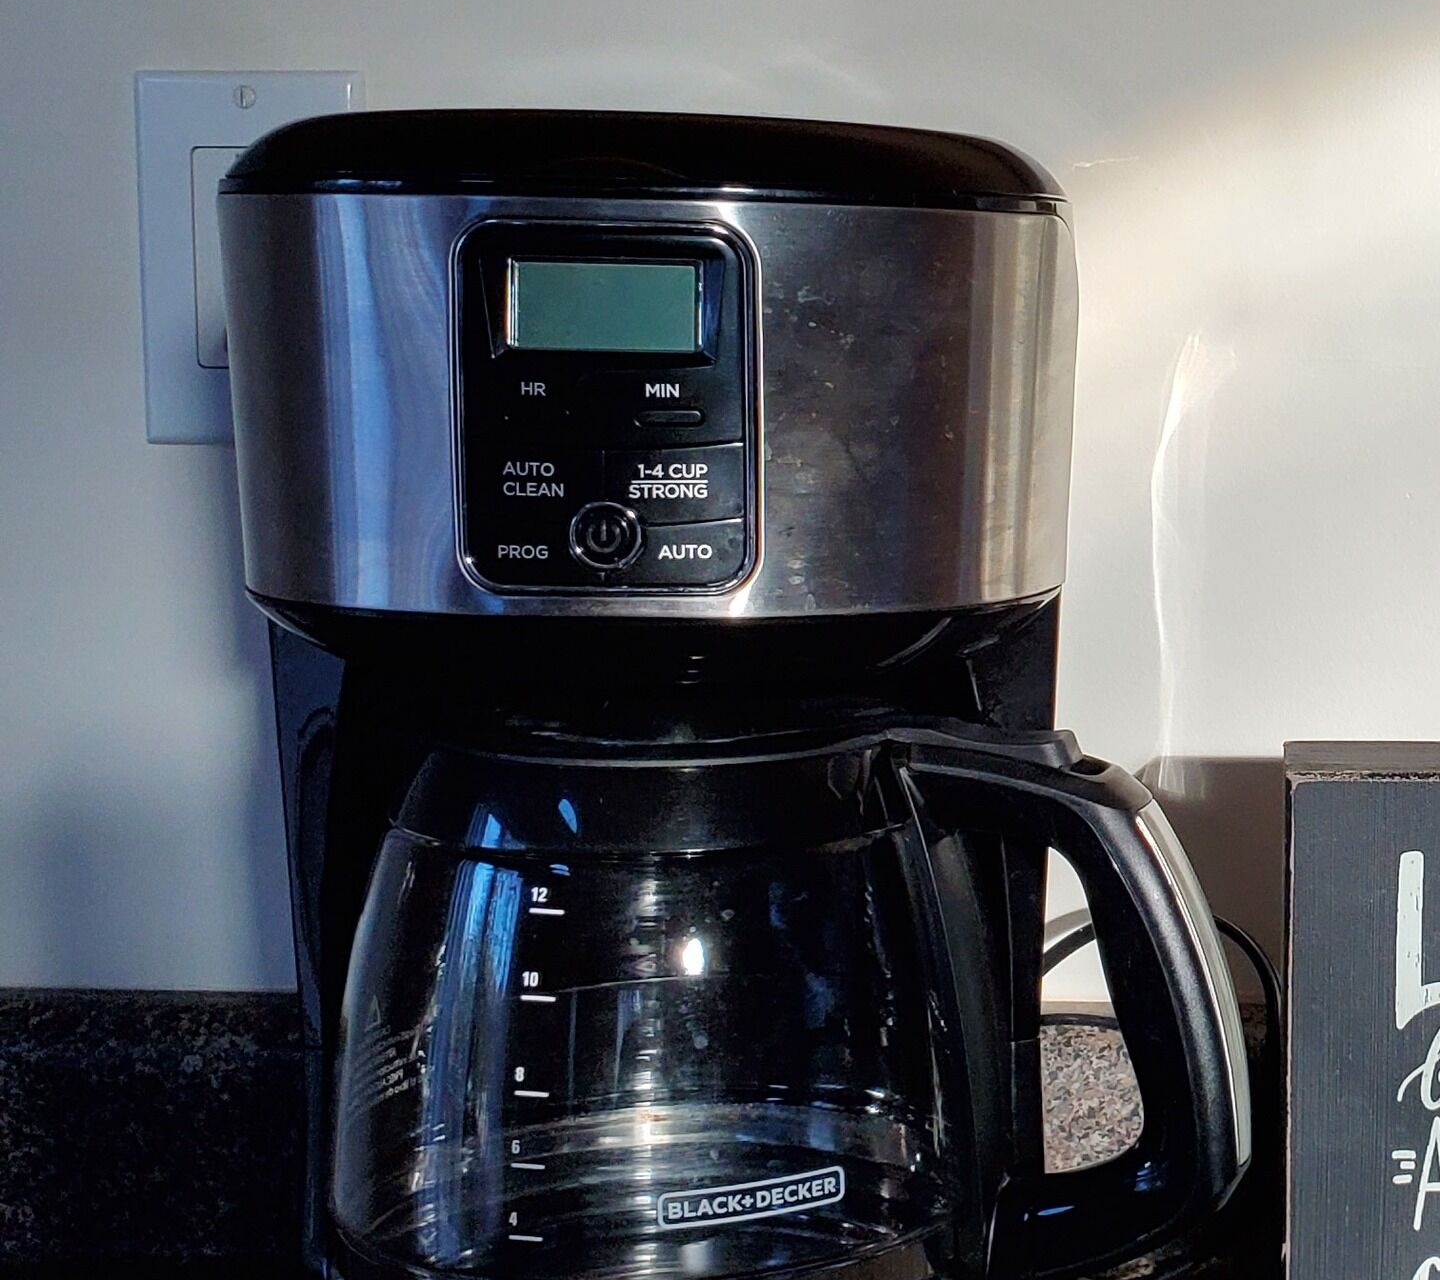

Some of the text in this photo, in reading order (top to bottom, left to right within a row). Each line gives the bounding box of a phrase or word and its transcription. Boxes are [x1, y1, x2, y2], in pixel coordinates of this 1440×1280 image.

[520, 382, 546, 397] HR
[644, 383, 680, 398] MIN
[502, 462, 555, 477] AUTO
[637, 463, 708, 478] 1-4 CUP
[503, 482, 565, 498] CLEAN
[628, 484, 709, 499] STRONG
[497, 545, 549, 560] PROG
[658, 544, 713, 560] AUTO
[530, 886, 549, 903] 12
[522, 971, 539, 988] 10
[514, 1066, 525, 1082] 8
[510, 1139, 521, 1155] 6
[667, 1176, 837, 1220] BLACK+DECKER
[508, 1211, 518, 1227] 4
